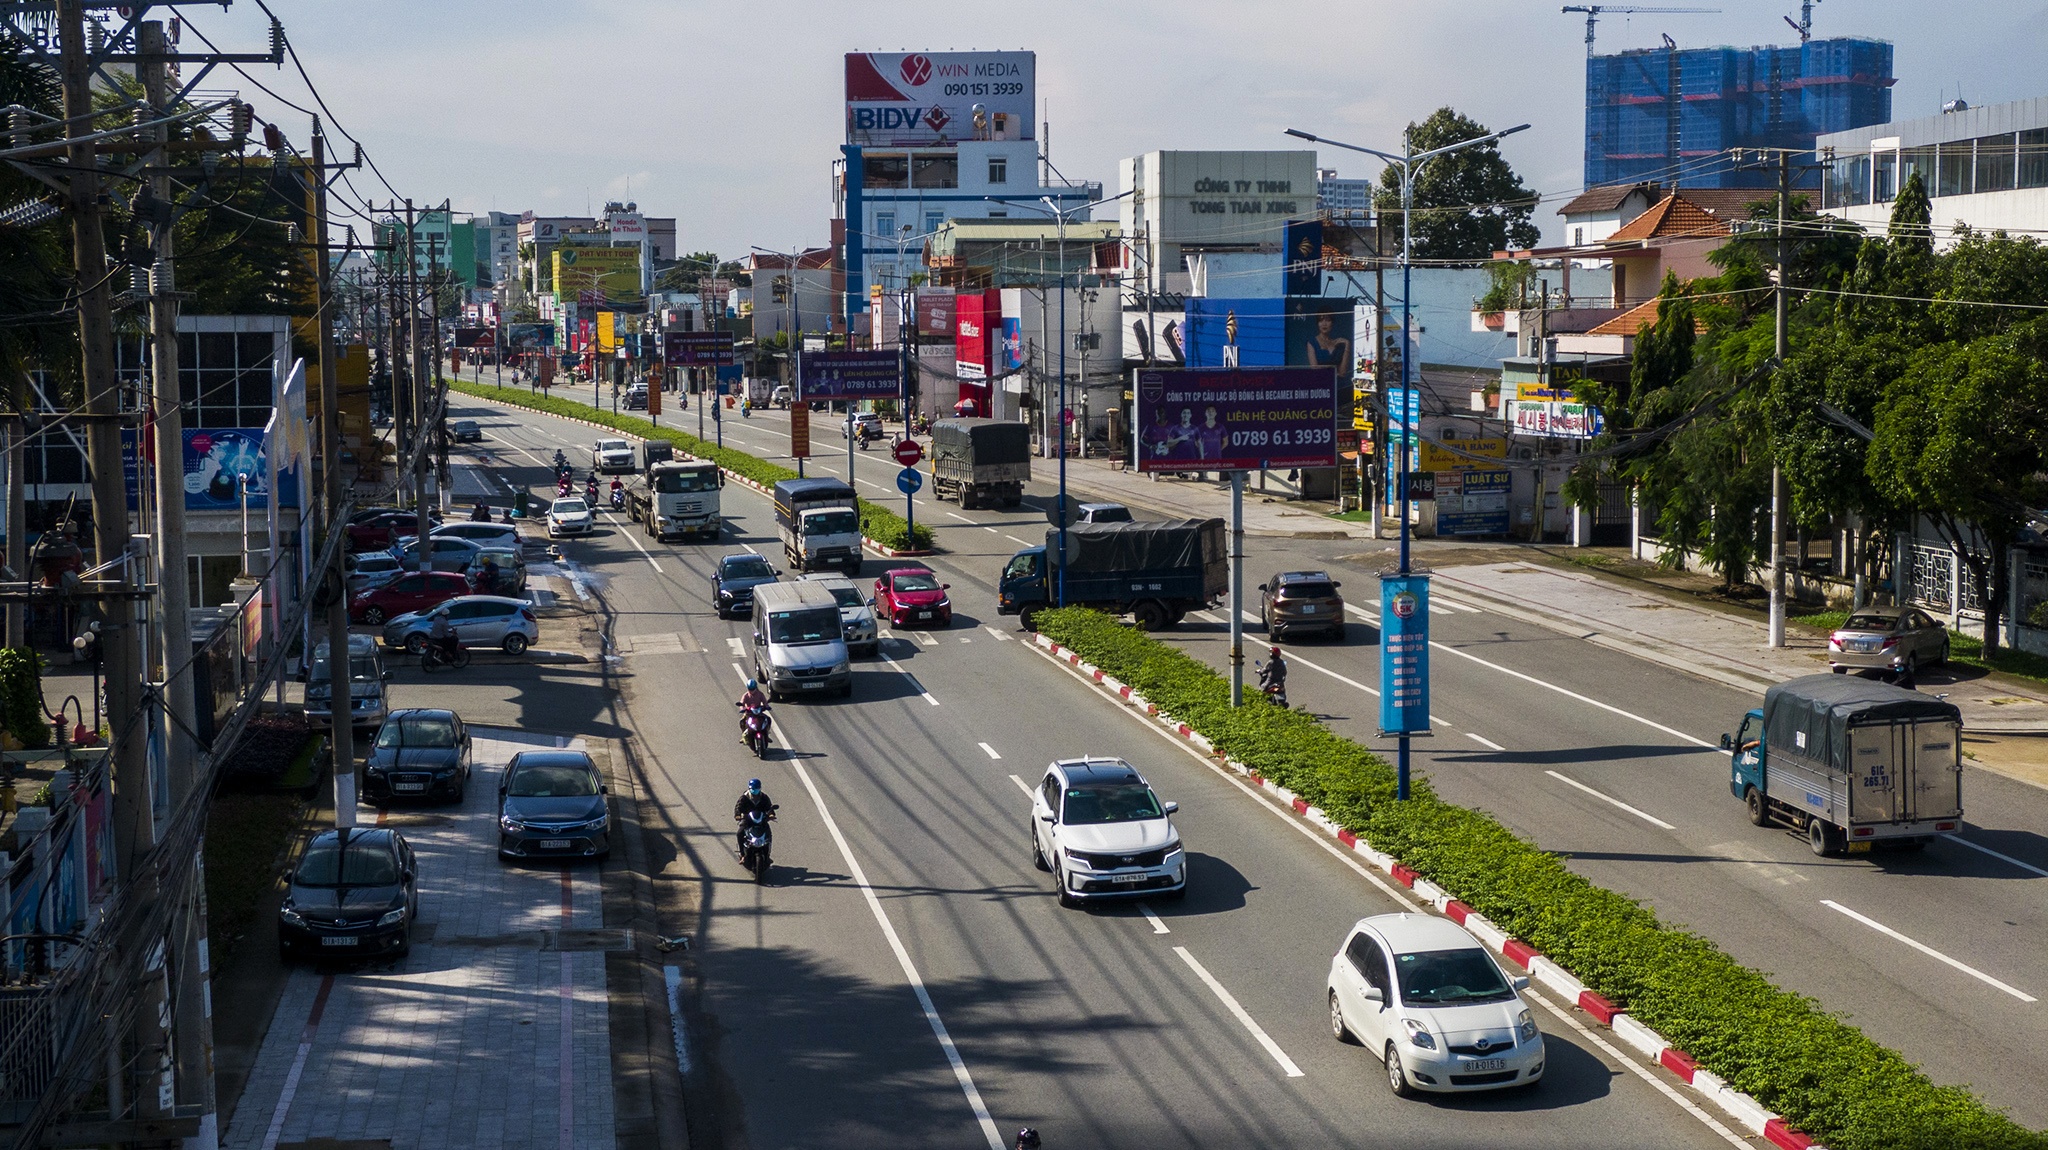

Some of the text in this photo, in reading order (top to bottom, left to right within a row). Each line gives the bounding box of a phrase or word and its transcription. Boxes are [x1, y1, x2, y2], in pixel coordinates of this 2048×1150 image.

[937, 63, 1020, 77] WIN MEDIA
[944, 82, 1023, 96] 090 151 3939
[857, 107, 922, 130] BIDV
[1194, 176, 1291, 193] CÔNG TY TNHH
[1190, 201, 1297, 214] TONG TIAN XING
[1293, 259, 1317, 277] PNJ
[846, 380, 896, 389] 0789 61 3939
[1167, 389, 1183, 402] CÔNG
[1184, 391, 1192, 401] TY
[1193, 391, 1202, 401] CP
[1238, 388, 1254, 401] BÓNG
[1265, 389, 1294, 400] BECAMEX
[1294, 387, 1309, 400] BÌNH
[1310, 388, 1331, 399] DƯƠNG
[1227, 407, 1332, 423] LIÊN HỆ QUẢNG CÁO
[1517, 410, 1548, 431] 세시봉
[1232, 428, 1331, 447] 0789 61 3939
[1149, 462, 1236, 470] www.becamexbinhduongfc.com
[1465, 472, 1509, 486] LUẬT SƯ
[1400, 605, 1412, 613] 5K
[1871, 766, 1885, 776] 61C
[1864, 776, 1889, 787] 265.71
